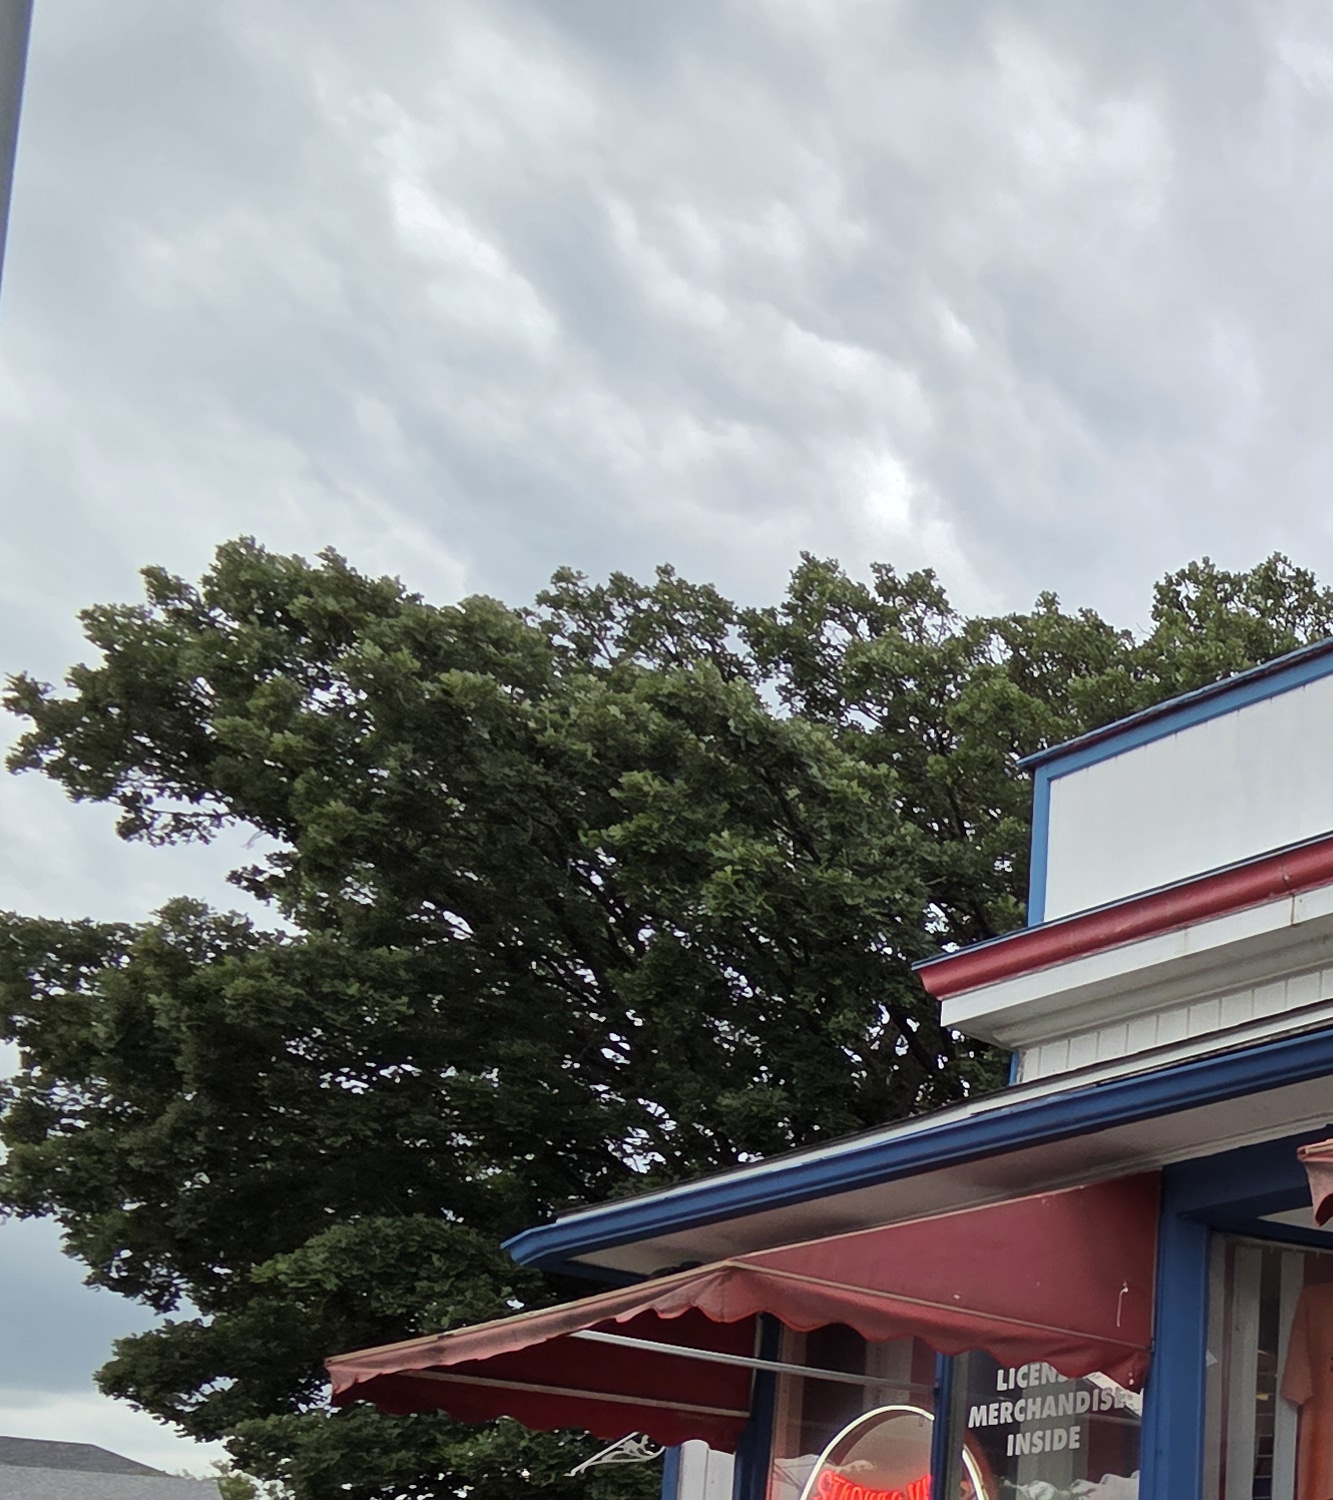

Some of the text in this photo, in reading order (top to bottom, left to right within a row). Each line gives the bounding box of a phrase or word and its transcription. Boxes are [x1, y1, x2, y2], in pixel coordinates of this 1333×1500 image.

[997, 1362, 1071, 1392] LICEN
[968, 1386, 1128, 1428] MERCHANDISE
[1006, 1426, 1081, 1457] INSIDE
